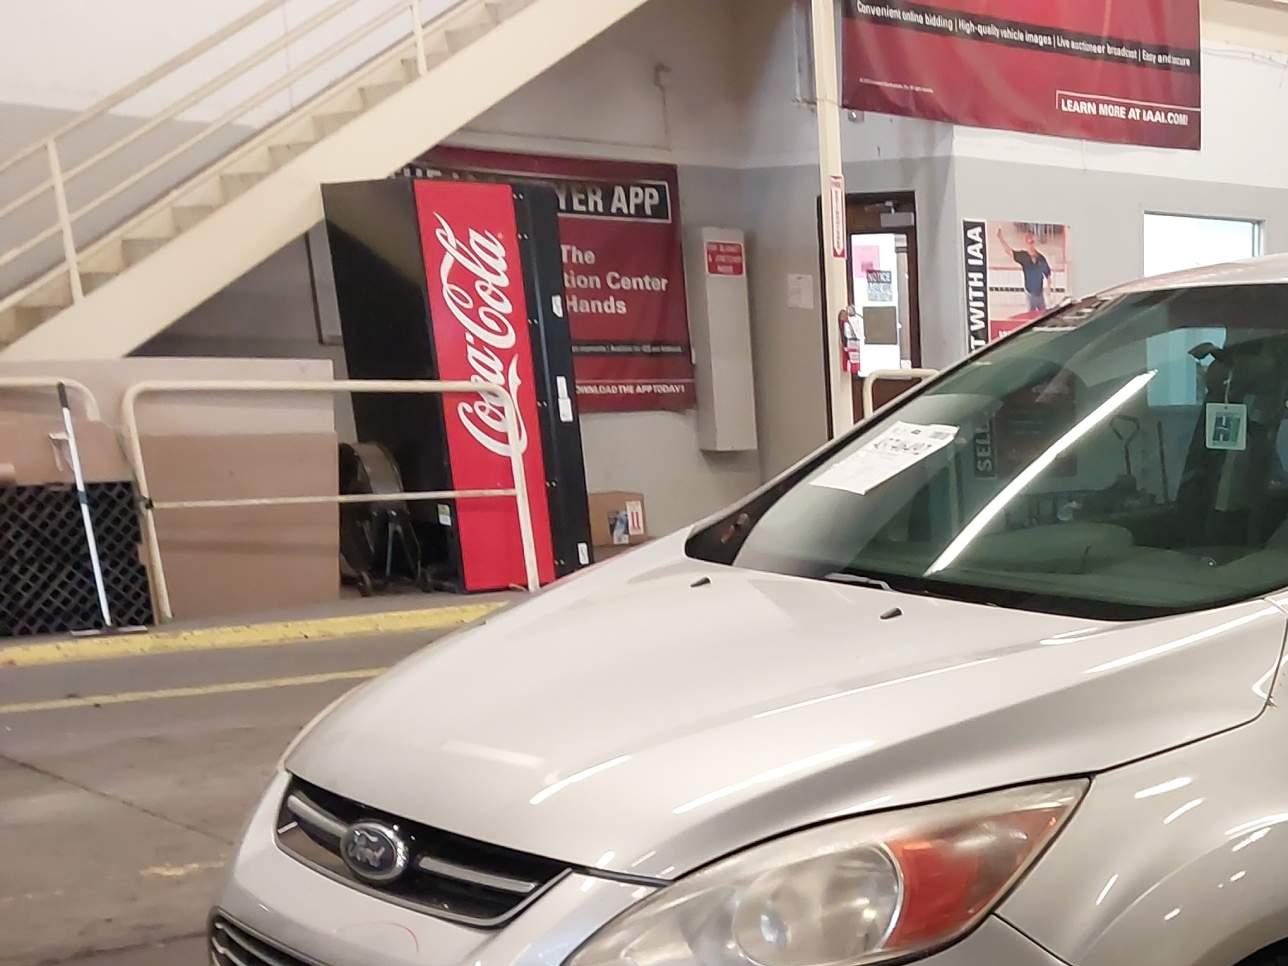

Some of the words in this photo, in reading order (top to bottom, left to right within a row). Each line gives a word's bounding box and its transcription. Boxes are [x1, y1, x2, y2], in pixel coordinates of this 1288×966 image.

[857, 0, 901, 20] Convenient
[902, 10, 923, 24] online
[924, 13, 953, 31] bidding
[959, 18, 999, 38] High-quality
[1000, 28, 1024, 42] vehicle
[1025, 30, 1052, 46] images
[1056, 35, 1070, 49] Live
[1070, 39, 1106, 54] auctioneer
[1106, 43, 1138, 59] broadcast
[1142, 49, 1156, 63] Easy
[1157, 53, 1171, 64] and
[1061, 98, 1096, 115] LEARN
[1098, 103, 1126, 119] MORE
[1127, 108, 1141, 121] AT
[610, 185, 660, 216] APP
[561, 244, 596, 264] The
[966, 226, 984, 266] IAA
[606, 271, 668, 291] Center
[566, 294, 627, 314] Hands
[967, 272, 985, 332] WITH
[635, 384, 653, 394] APP
